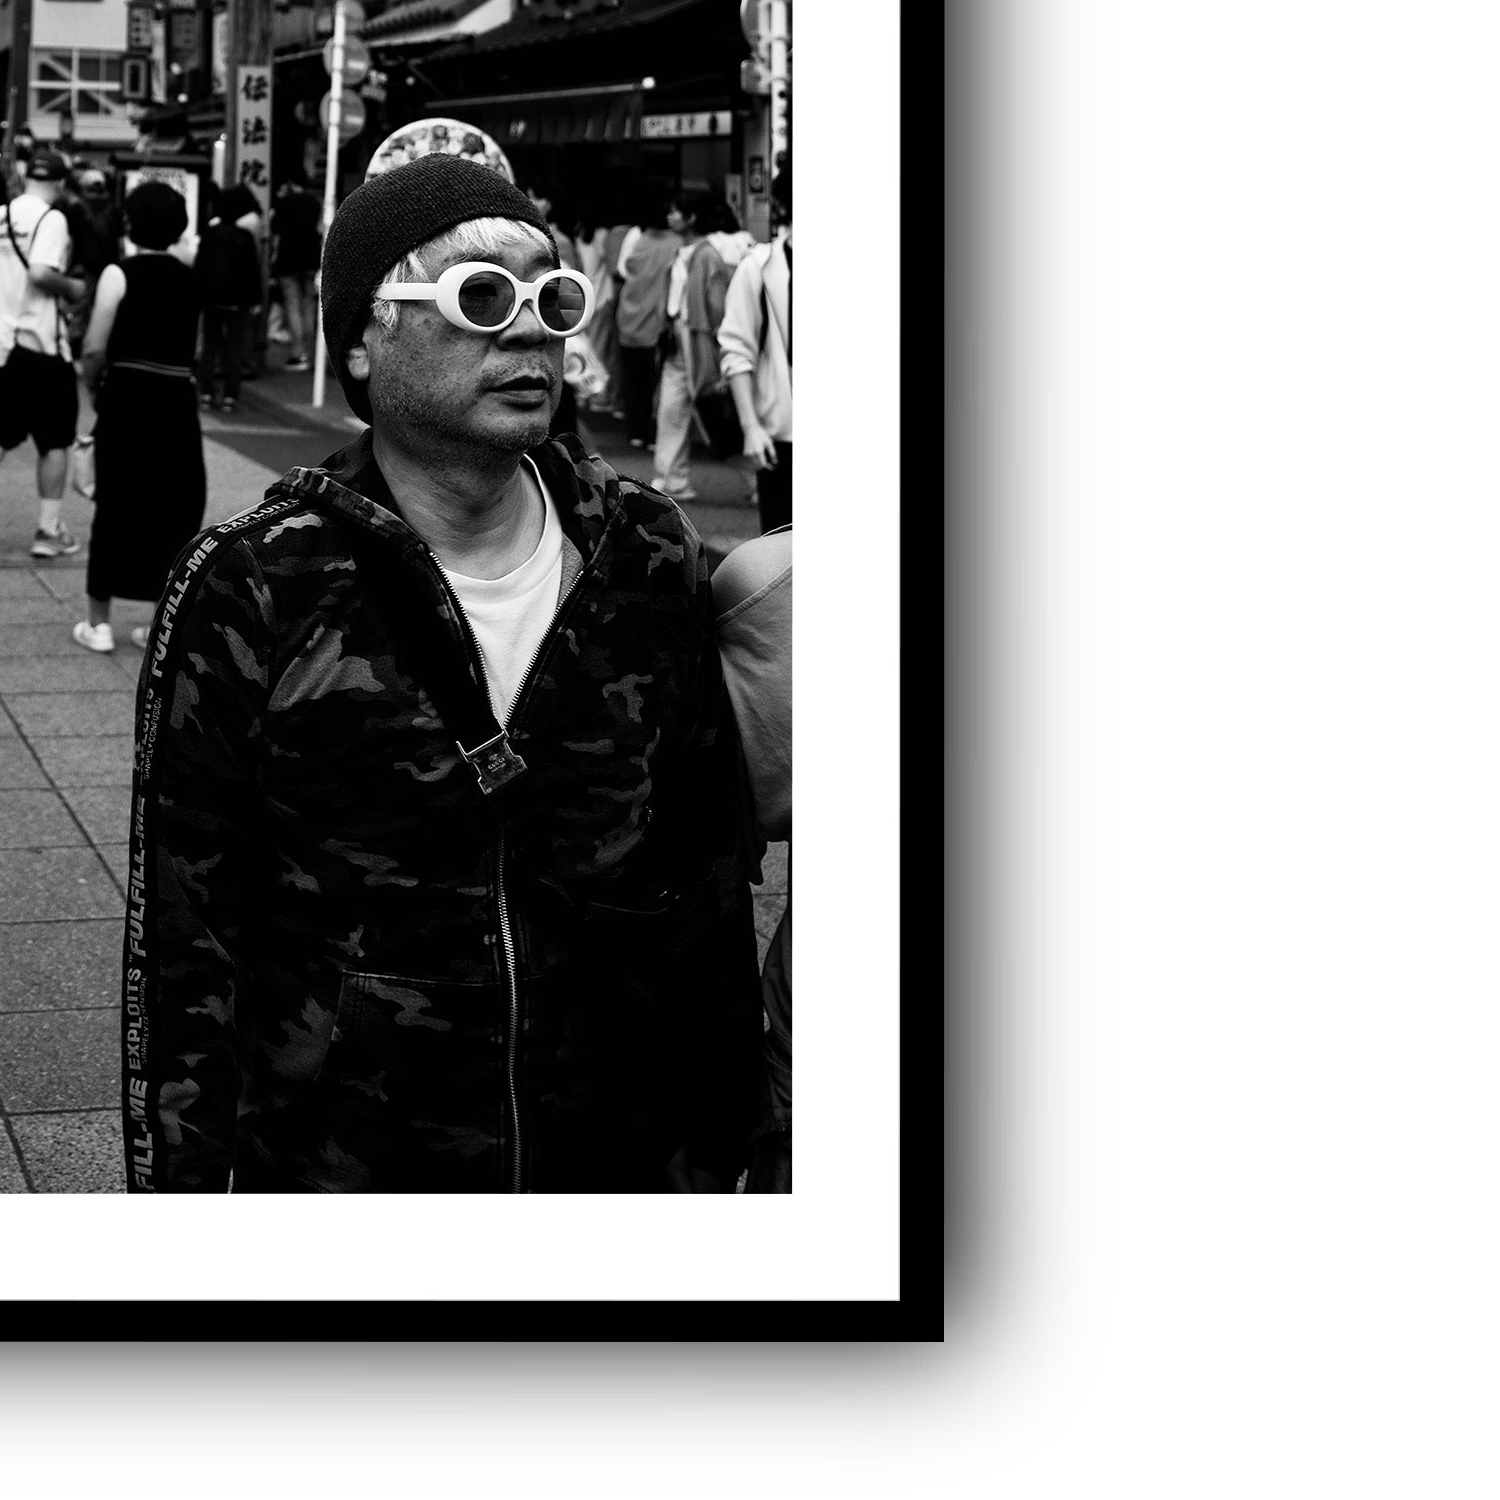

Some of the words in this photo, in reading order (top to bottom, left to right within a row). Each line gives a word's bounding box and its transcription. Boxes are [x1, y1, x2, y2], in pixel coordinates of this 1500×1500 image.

[241, 74, 268, 187] 伝法院
[151, 536, 219, 678] FULFILL-ME
[129, 794, 147, 958] FULFILL-ME
[126, 967, 142, 1071] EXPLOITS
